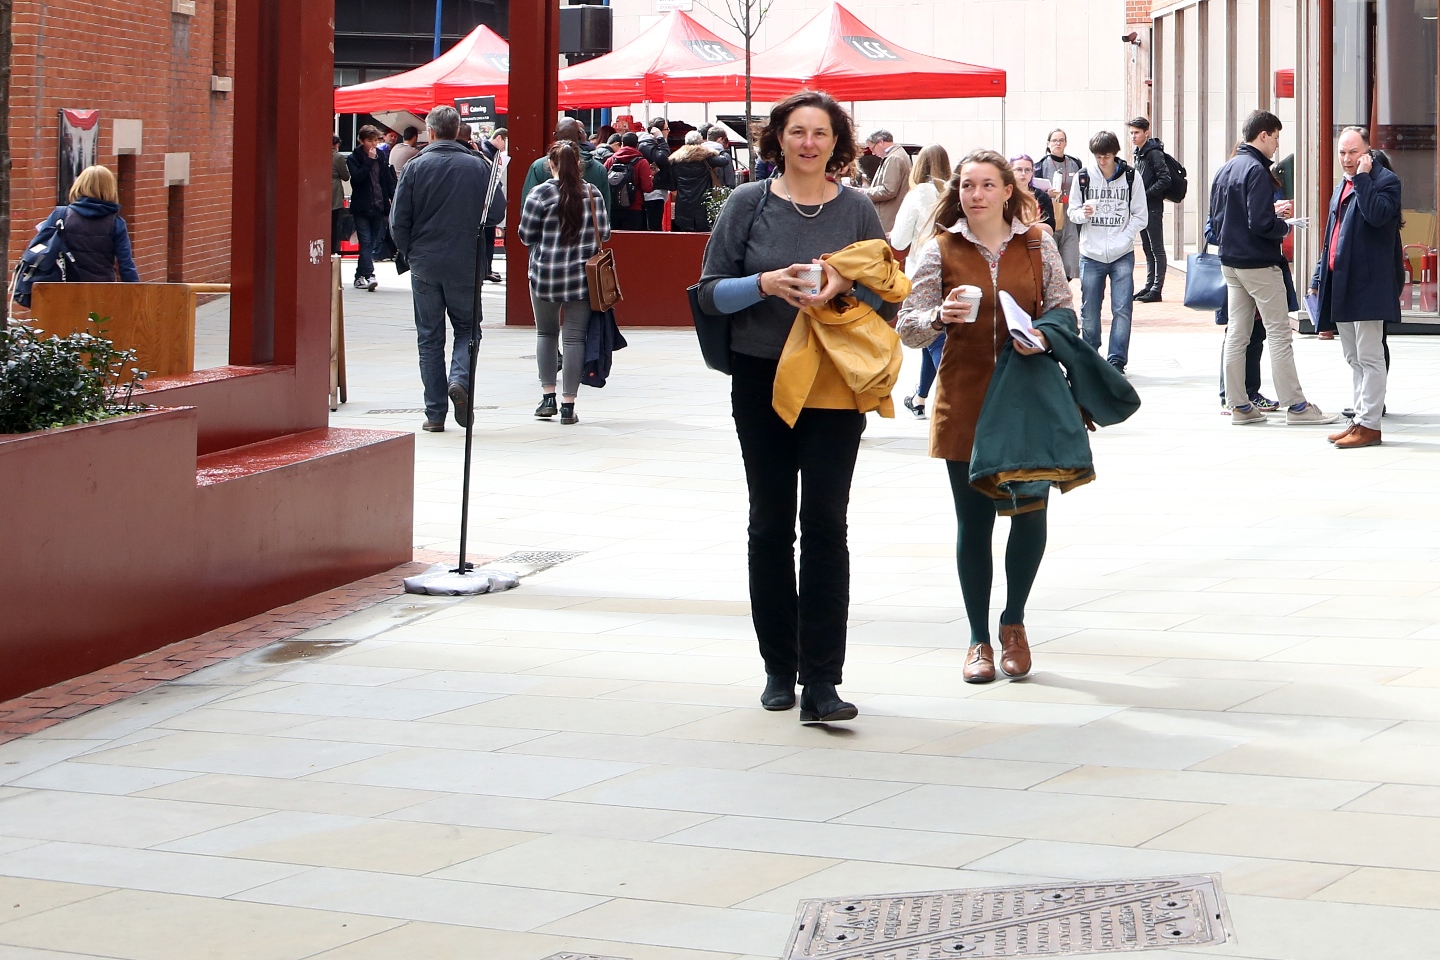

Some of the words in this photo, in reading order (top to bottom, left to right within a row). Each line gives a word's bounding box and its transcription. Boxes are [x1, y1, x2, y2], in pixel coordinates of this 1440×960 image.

[692, 44, 735, 61] LSE
[851, 40, 897, 59] LSE
[489, 56, 510, 72] LS
